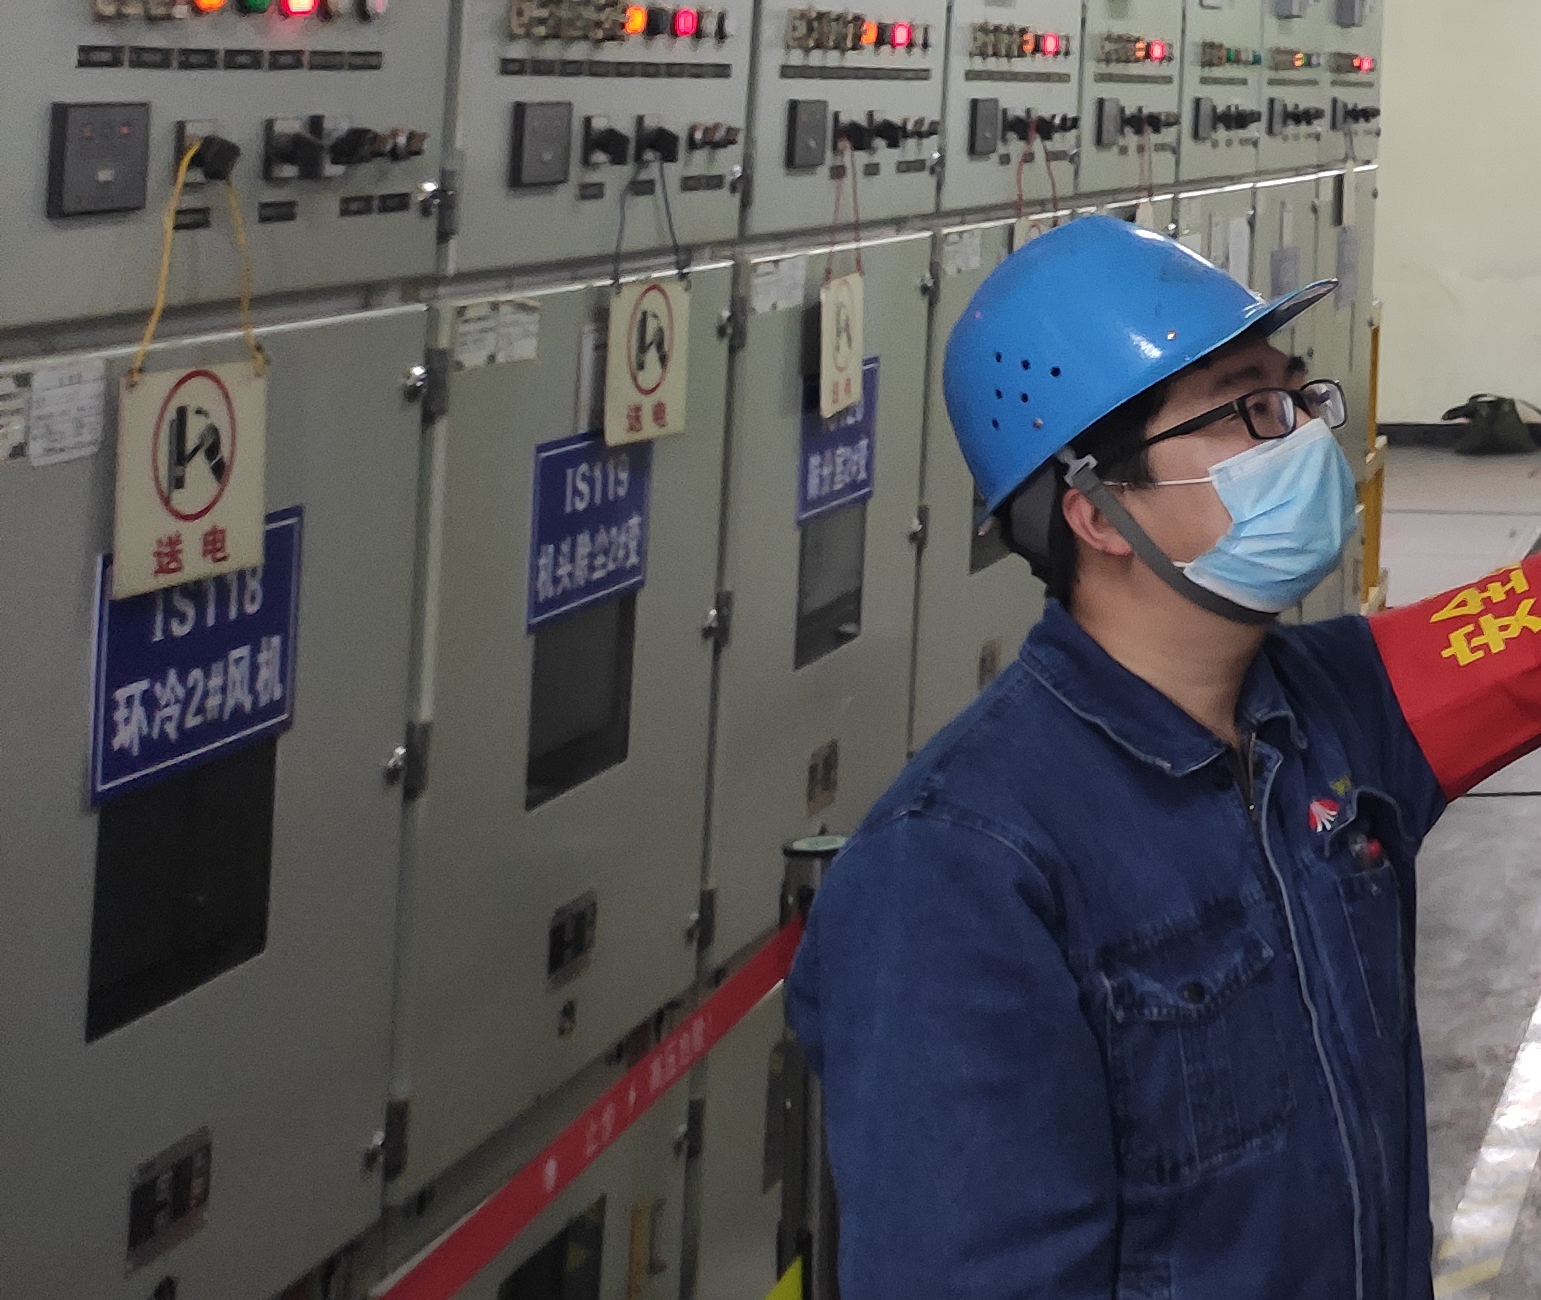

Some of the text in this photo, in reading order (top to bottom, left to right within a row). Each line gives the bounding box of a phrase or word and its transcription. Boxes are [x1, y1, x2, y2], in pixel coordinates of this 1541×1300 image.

[152, 526, 229, 578] 送电
[110, 634, 284, 756] 环冷2#风机
